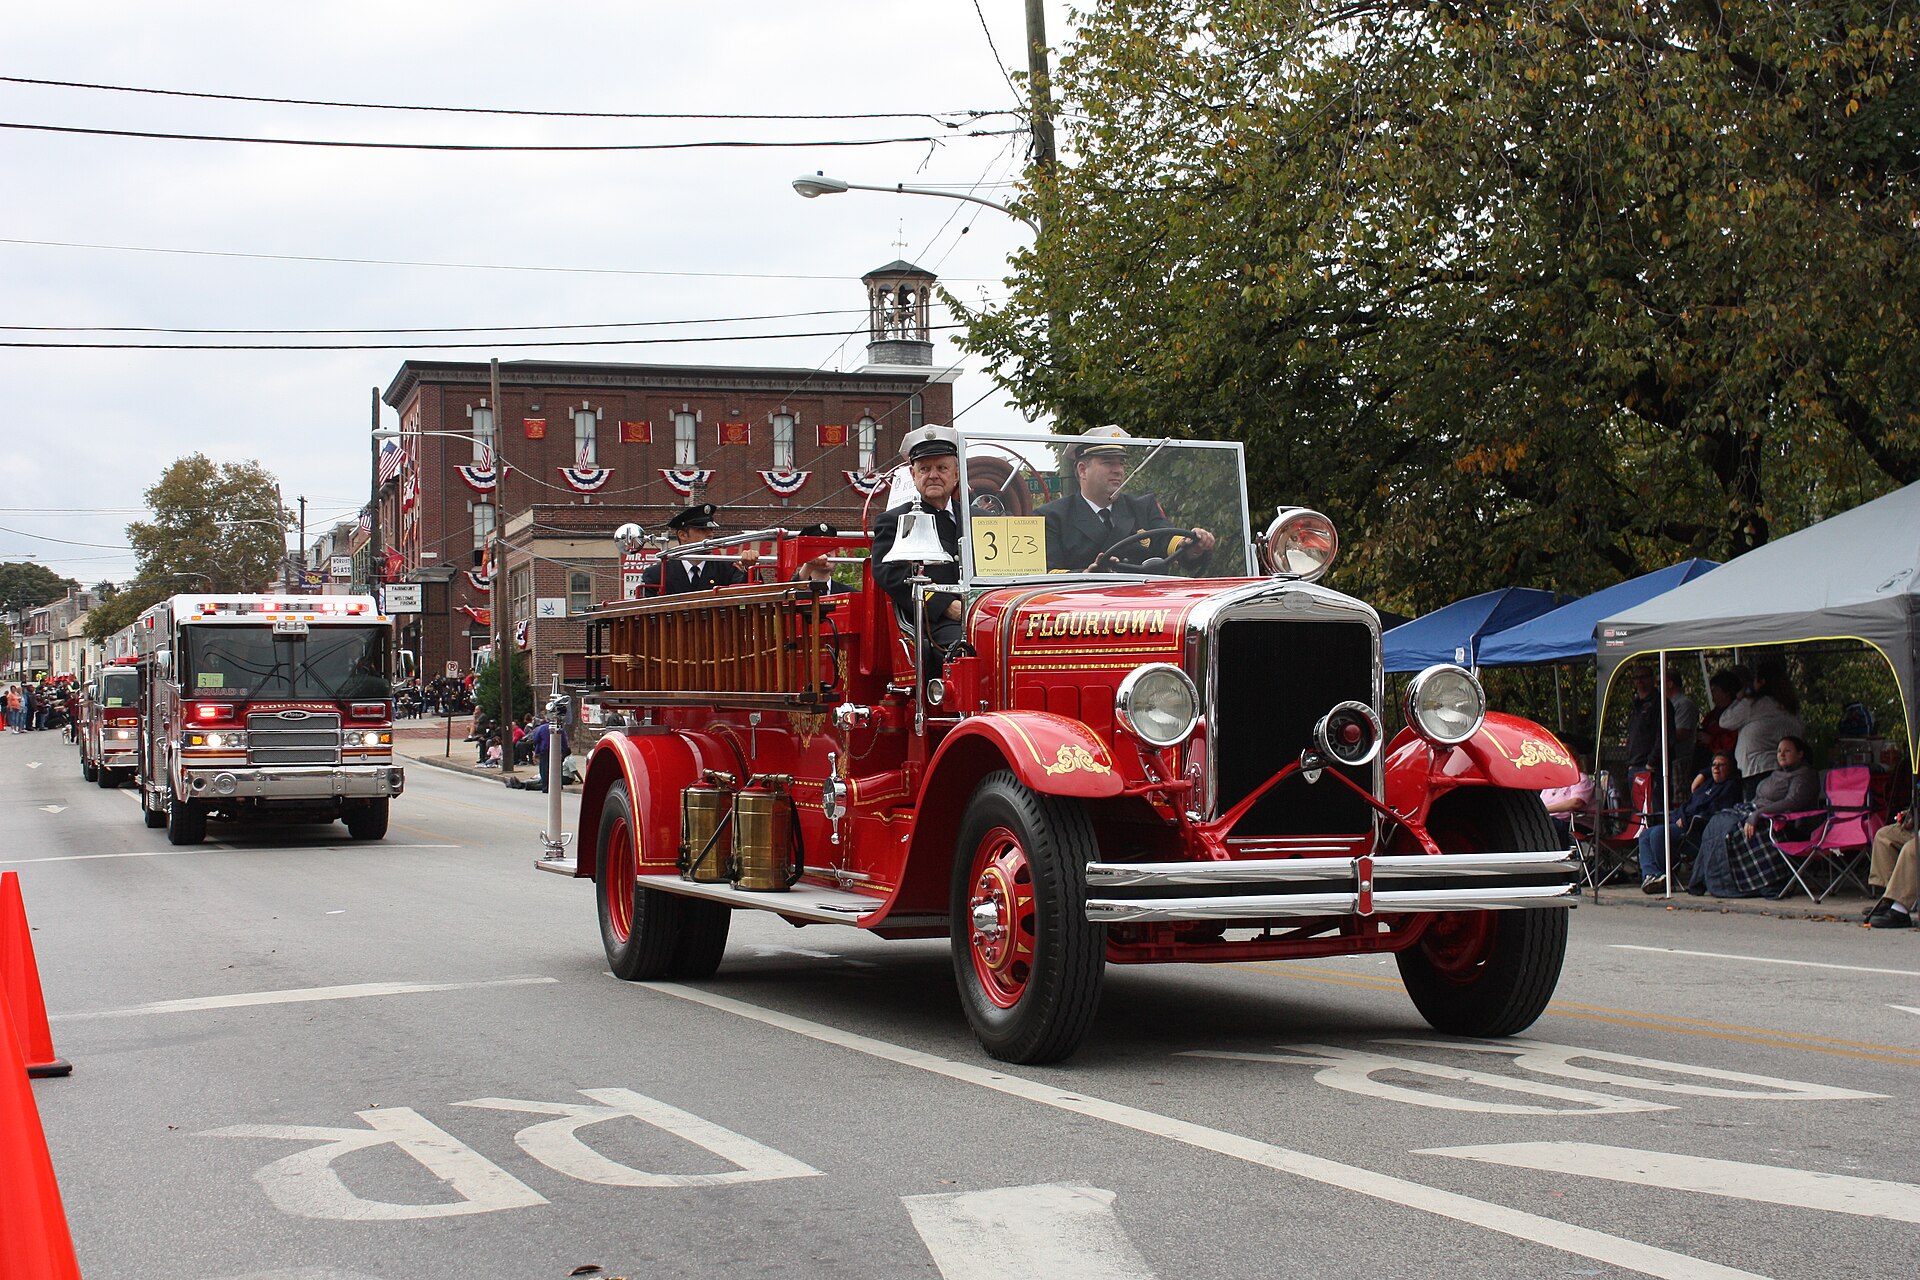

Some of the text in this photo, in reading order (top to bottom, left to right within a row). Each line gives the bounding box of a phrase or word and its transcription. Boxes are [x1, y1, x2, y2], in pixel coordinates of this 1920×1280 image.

[982, 531, 998, 561] 3
[1011, 535, 1039, 555] 23
[1026, 608, 1172, 638] FLOURTOWN
[193, 687, 238, 697] SQUAD
